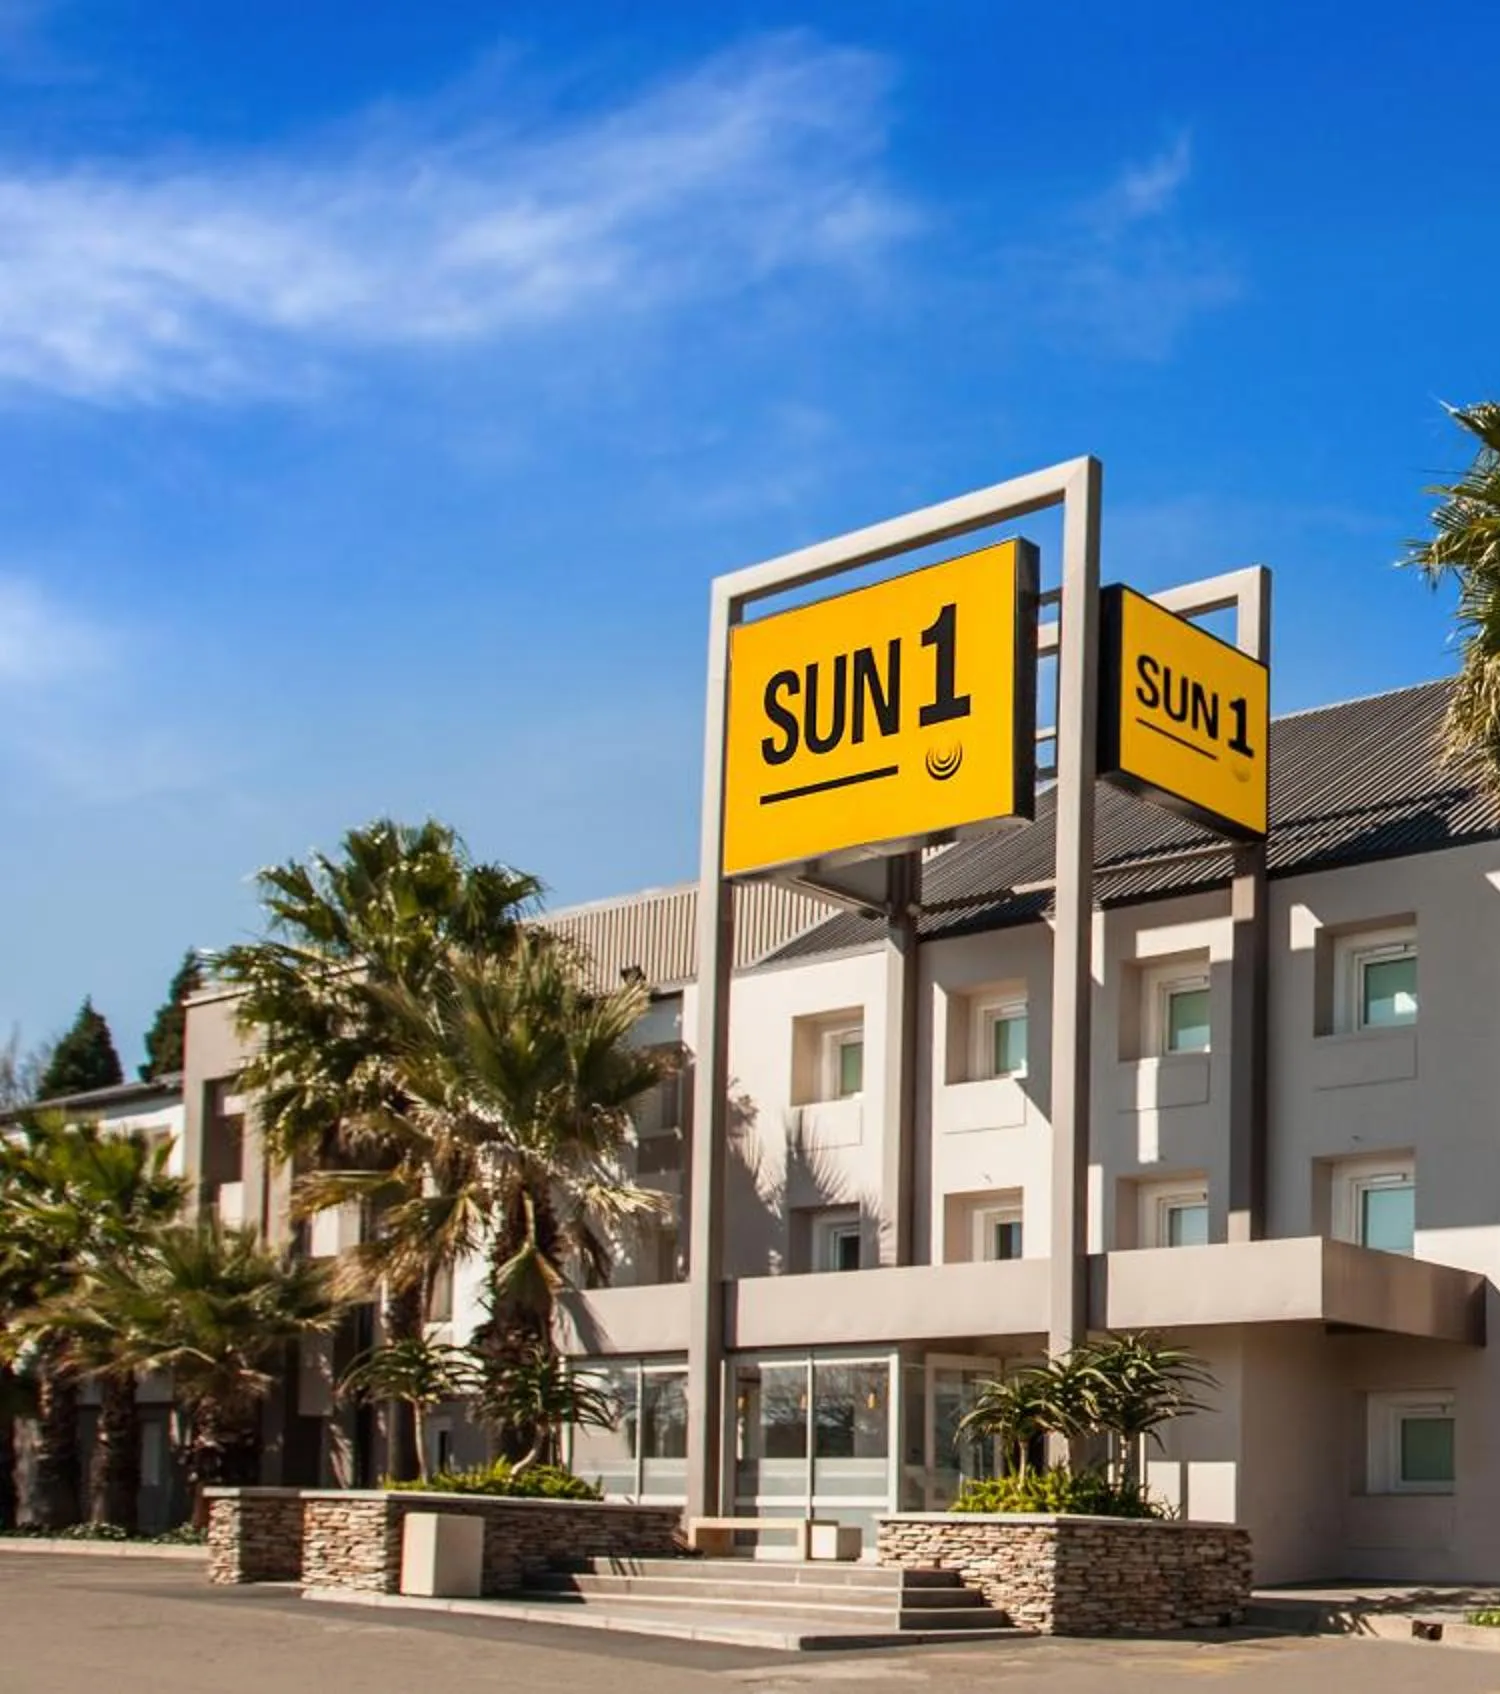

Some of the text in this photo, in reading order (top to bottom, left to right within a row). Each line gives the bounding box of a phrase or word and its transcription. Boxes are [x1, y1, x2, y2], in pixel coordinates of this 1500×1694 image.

[760, 603, 971, 766] SUN 1
[1135, 654, 1254, 758] SUN 1
